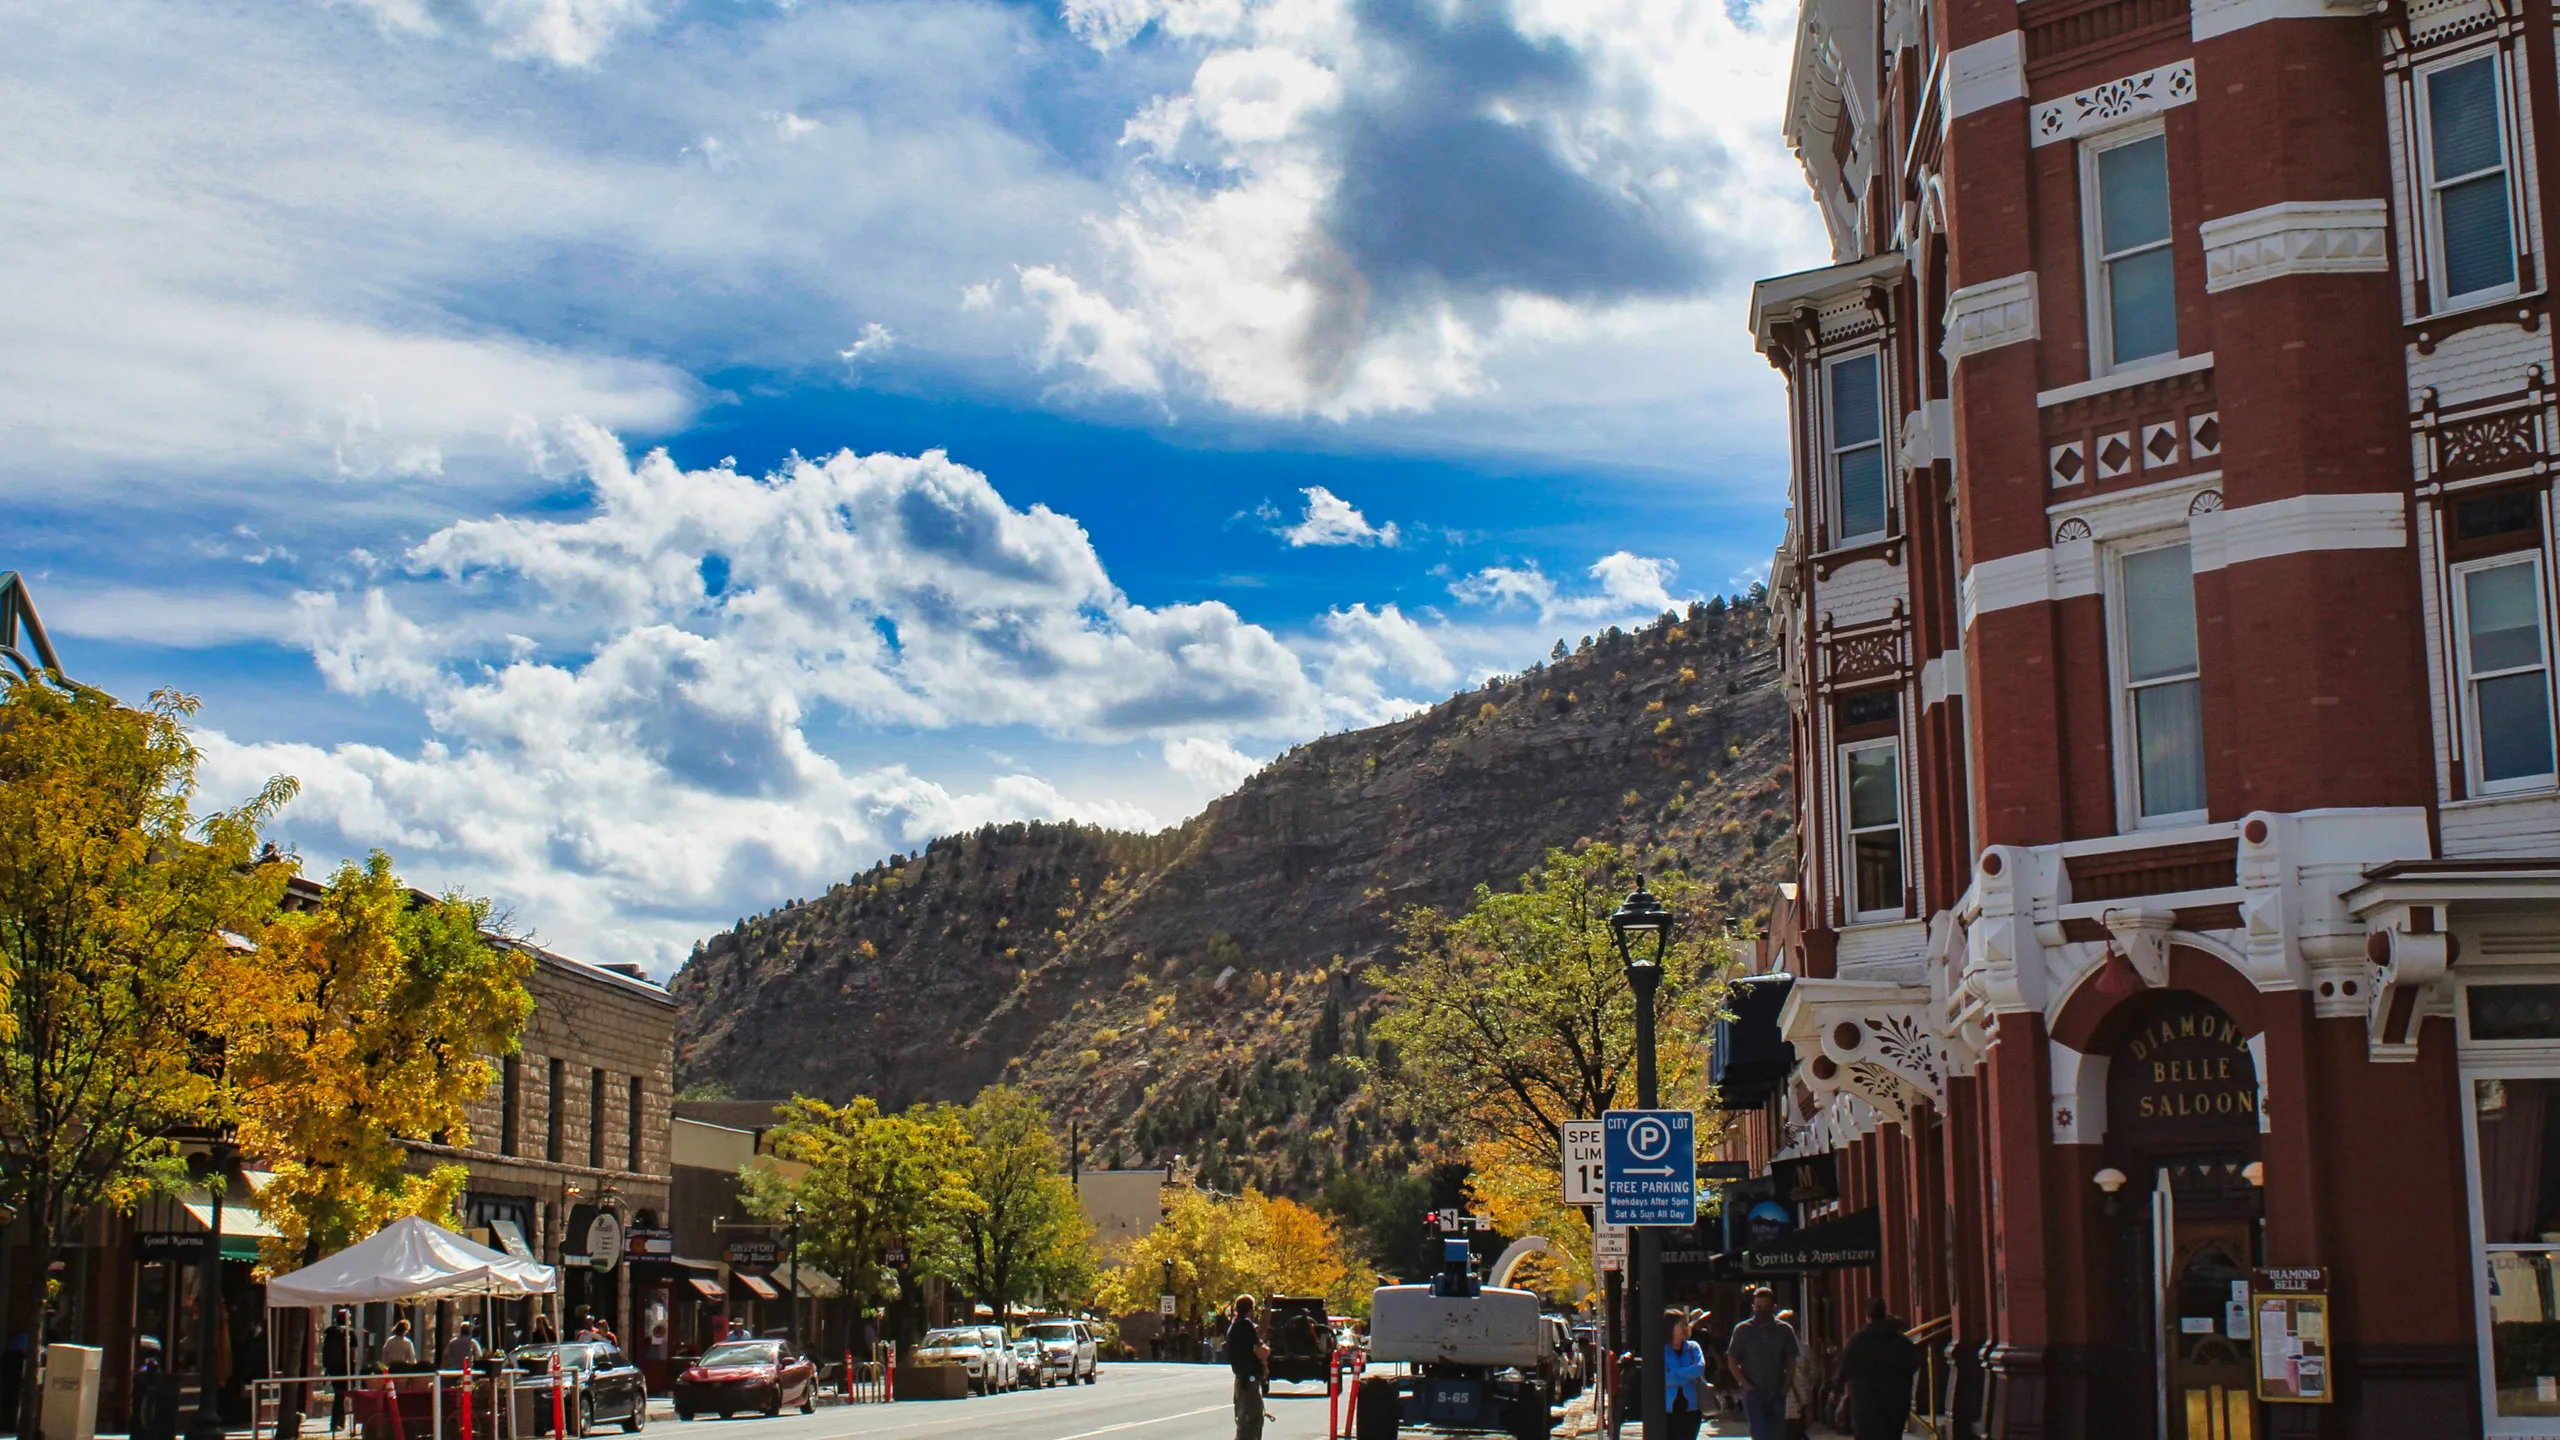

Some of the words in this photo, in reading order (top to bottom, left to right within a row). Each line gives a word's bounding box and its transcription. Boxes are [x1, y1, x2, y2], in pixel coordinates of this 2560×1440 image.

[2153, 1058, 2230, 1083] BELLE
[2140, 1091, 2253, 1117] SALOON
[1607, 1118, 1628, 1129] CITY
[1672, 1118, 1689, 1129] LOT
[1568, 1130, 1601, 1143] SPE
[1574, 1147, 1602, 1160] LIM
[1578, 1164, 1604, 1194] 15
[1609, 1181, 1638, 1193] FREE
[1641, 1181, 1690, 1193] PARKING
[1610, 1197, 1648, 1207] Weekdays
[1651, 1197, 1669, 1206] After
[1671, 1197, 1689, 1207] 5pm
[1615, 1209, 1628, 1218] Sat
[1630, 1209, 1637, 1218] &
[1640, 1209, 1655, 1218] Sun
[1657, 1209, 1668, 1218] All
[1670, 1209, 1685, 1220] Day
[144, 1235, 169, 1247] Good
[171, 1235, 204, 1247] Karma
[733, 1253, 749, 1262] My
[751, 1252, 775, 1261] Back
[885, 1253, 905, 1265] TOYS
[1660, 1251, 1715, 1263] HEATR
[1755, 1252, 1794, 1266] Spirits
[1797, 1252, 1807, 1263] &
[1810, 1249, 1876, 1263] Appetizers
[2269, 1269, 2321, 1280] DIAMOND
[2274, 1280, 2308, 1290] BELLE
[1437, 1391, 1469, 1404] S-65
